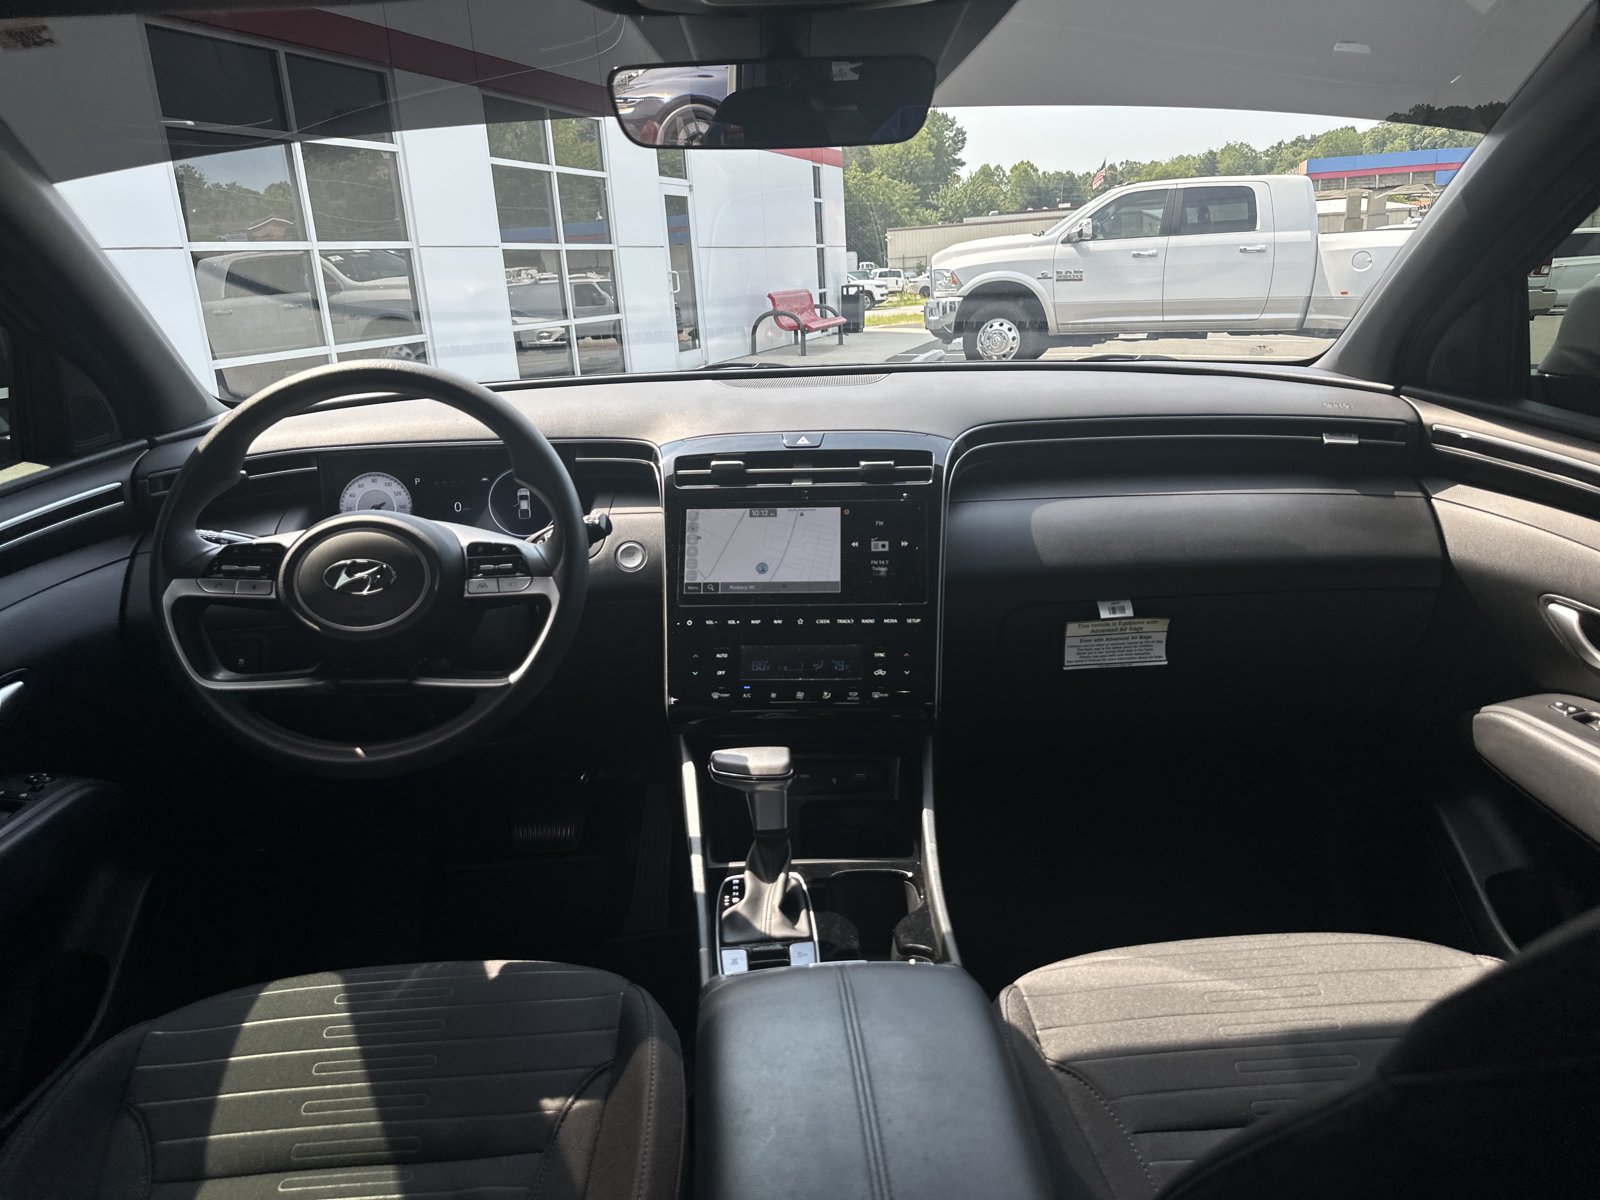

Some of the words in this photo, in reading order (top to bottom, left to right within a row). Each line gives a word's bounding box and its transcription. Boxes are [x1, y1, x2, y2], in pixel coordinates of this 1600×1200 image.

[414, 477, 421, 485] P
[454, 501, 462, 512] 0
[751, 509, 769, 517] 10:12
